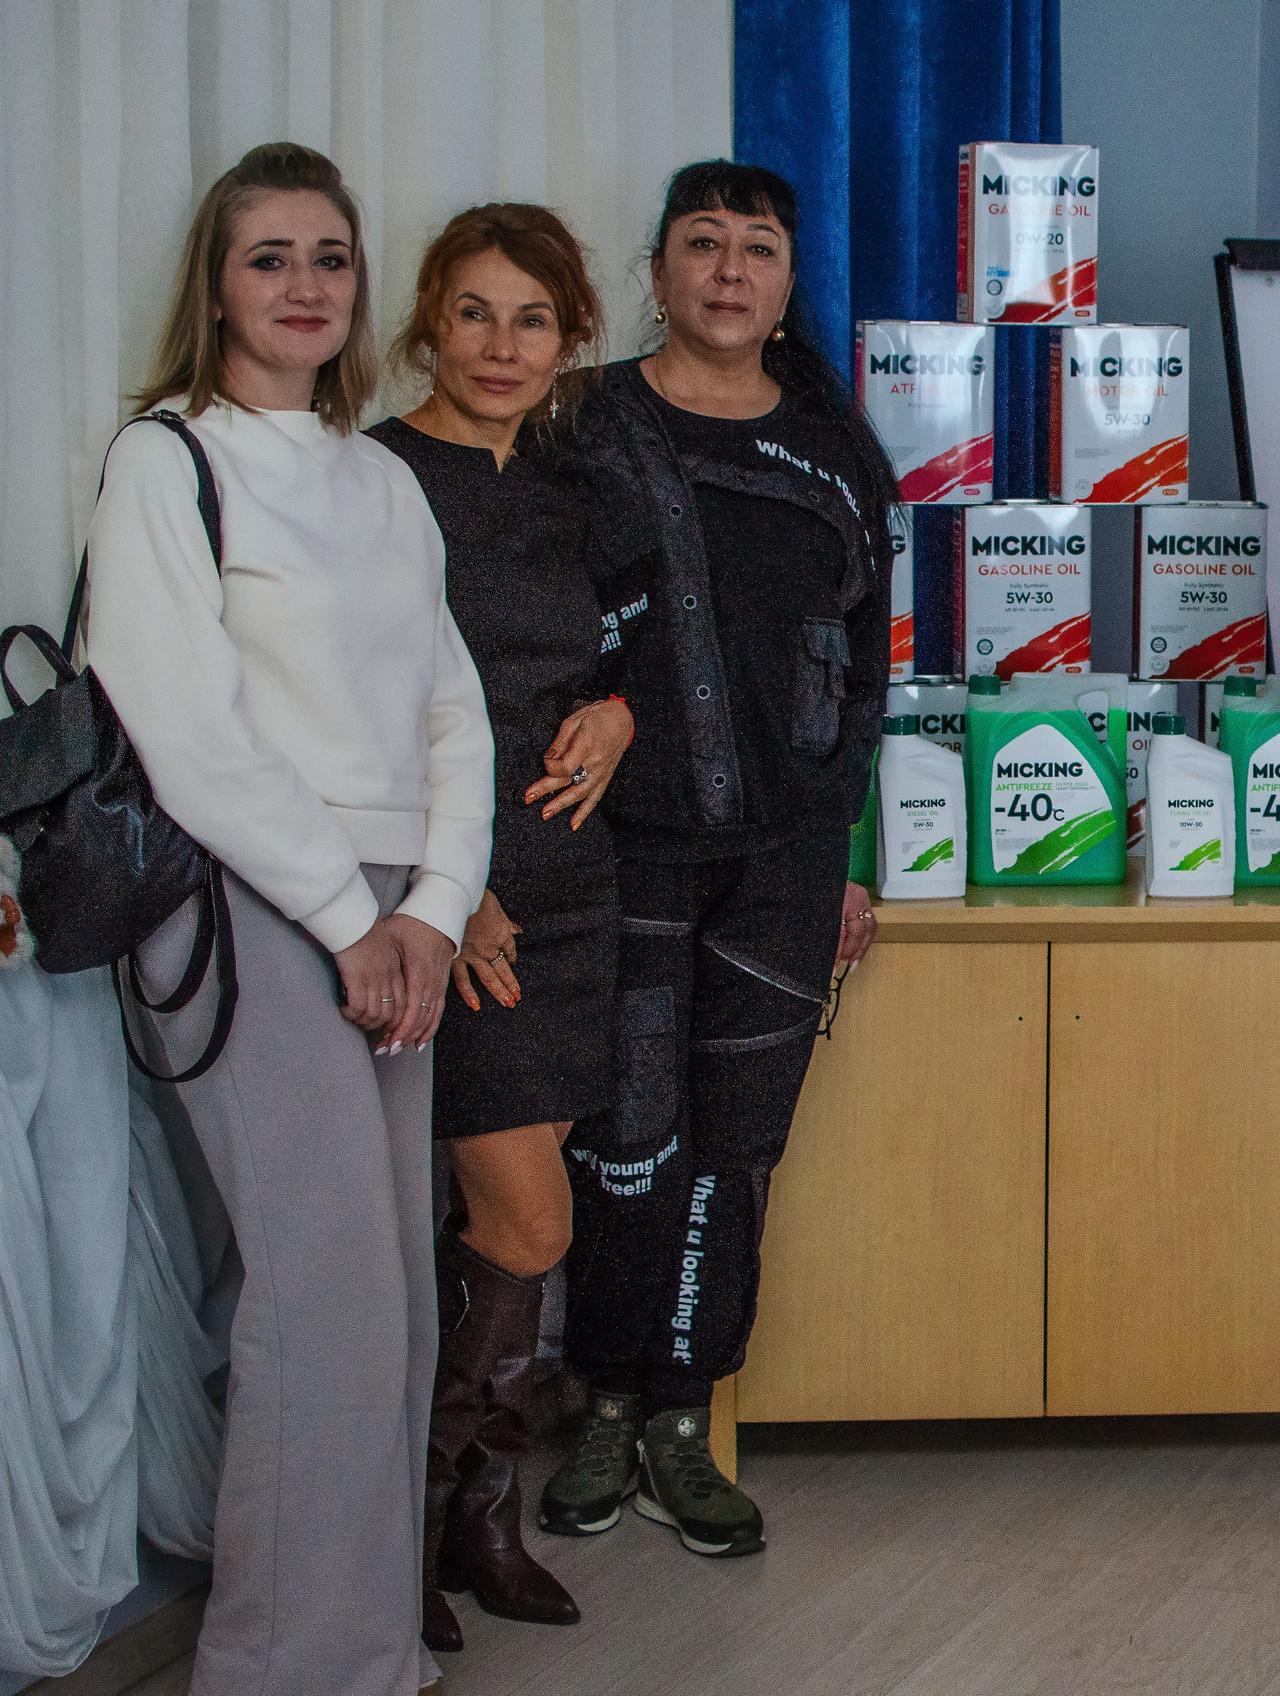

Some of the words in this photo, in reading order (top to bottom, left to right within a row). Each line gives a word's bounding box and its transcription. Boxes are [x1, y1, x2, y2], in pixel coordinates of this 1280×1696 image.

[982, 174, 1096, 197] MICKING
[1069, 205, 1091, 217] OIL
[1015, 233, 1064, 246] 0W-20
[870, 353, 986, 376] MICKING
[1070, 356, 1183, 377] MICKING
[1146, 385, 1169, 397] OIL
[1104, 413, 1151, 426] 5W-30
[755, 439, 813, 474] What
[817, 468, 831, 482] u
[971, 535, 1086, 557] MICKING
[1147, 534, 1261, 557] MICKING
[978, 563, 1053, 576] GASOLINE
[1057, 563, 1081, 575] OIL
[1153, 563, 1227, 576] GASOLINE
[1231, 563, 1256, 576] OIL
[1006, 591, 1054, 605] 5W-30
[1180, 591, 1228, 604] 5W-30
[620, 593, 648, 620] and
[915, 714, 966, 734] ICKI
[1132, 739, 1148, 751] OI
[996, 762, 1083, 778] MICKING
[995, 782, 1053, 792] ANTIFREEZE
[900, 798, 946, 809] MICKING
[1167, 799, 1215, 808] MICKING
[599, 1158, 654, 1176] young
[656, 1136, 679, 1165] and
[686, 1229, 702, 1246] u
[671, 1250, 705, 1331] looking
